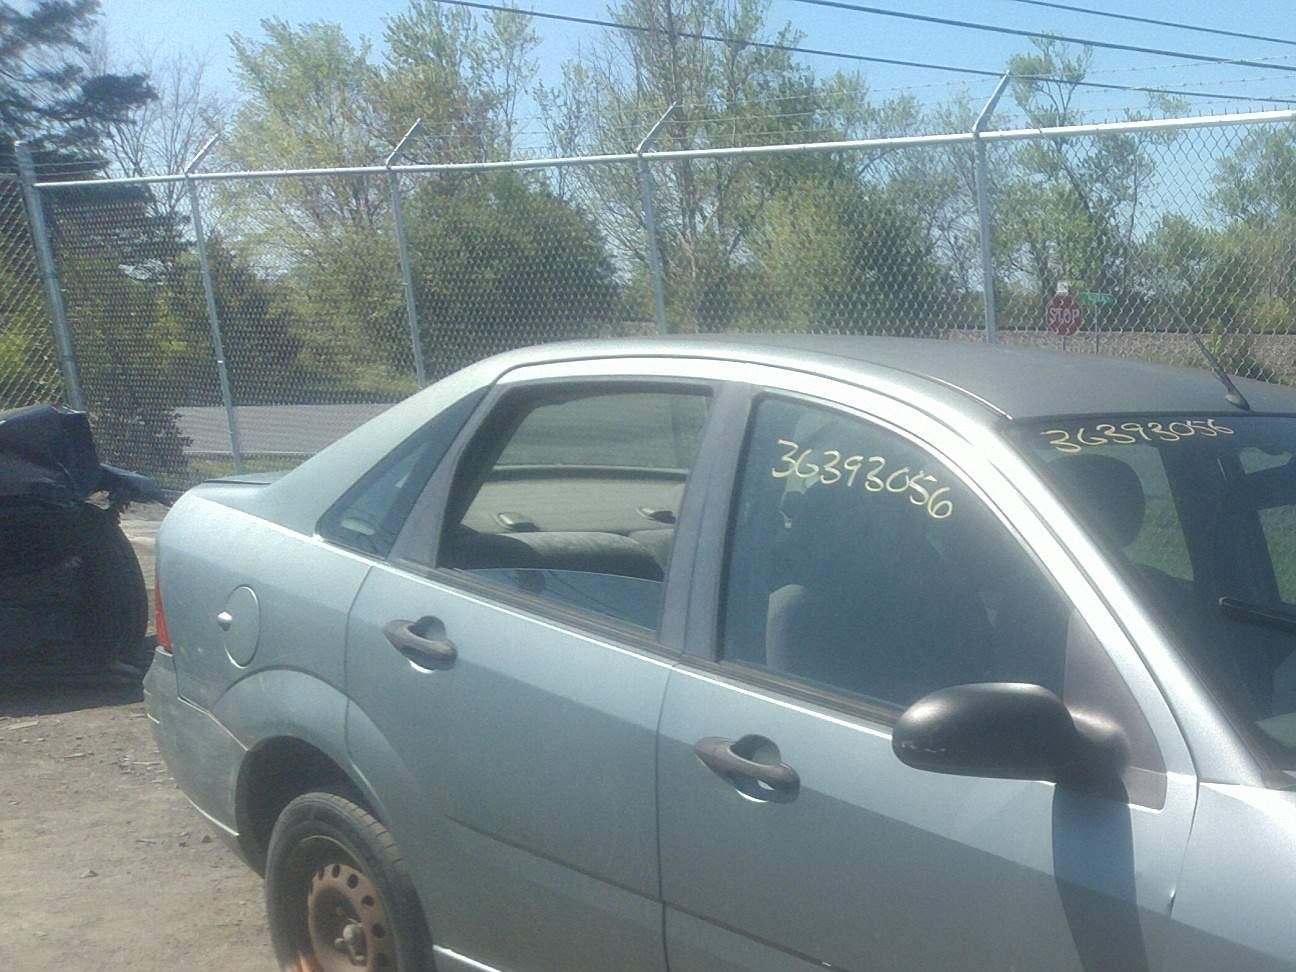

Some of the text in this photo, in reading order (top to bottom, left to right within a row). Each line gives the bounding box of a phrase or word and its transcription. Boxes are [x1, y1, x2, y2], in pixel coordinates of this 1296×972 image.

[1049, 307, 1080, 324] STOP
[1040, 418, 1235, 453] 36393056
[771, 439, 953, 519] 36393056
